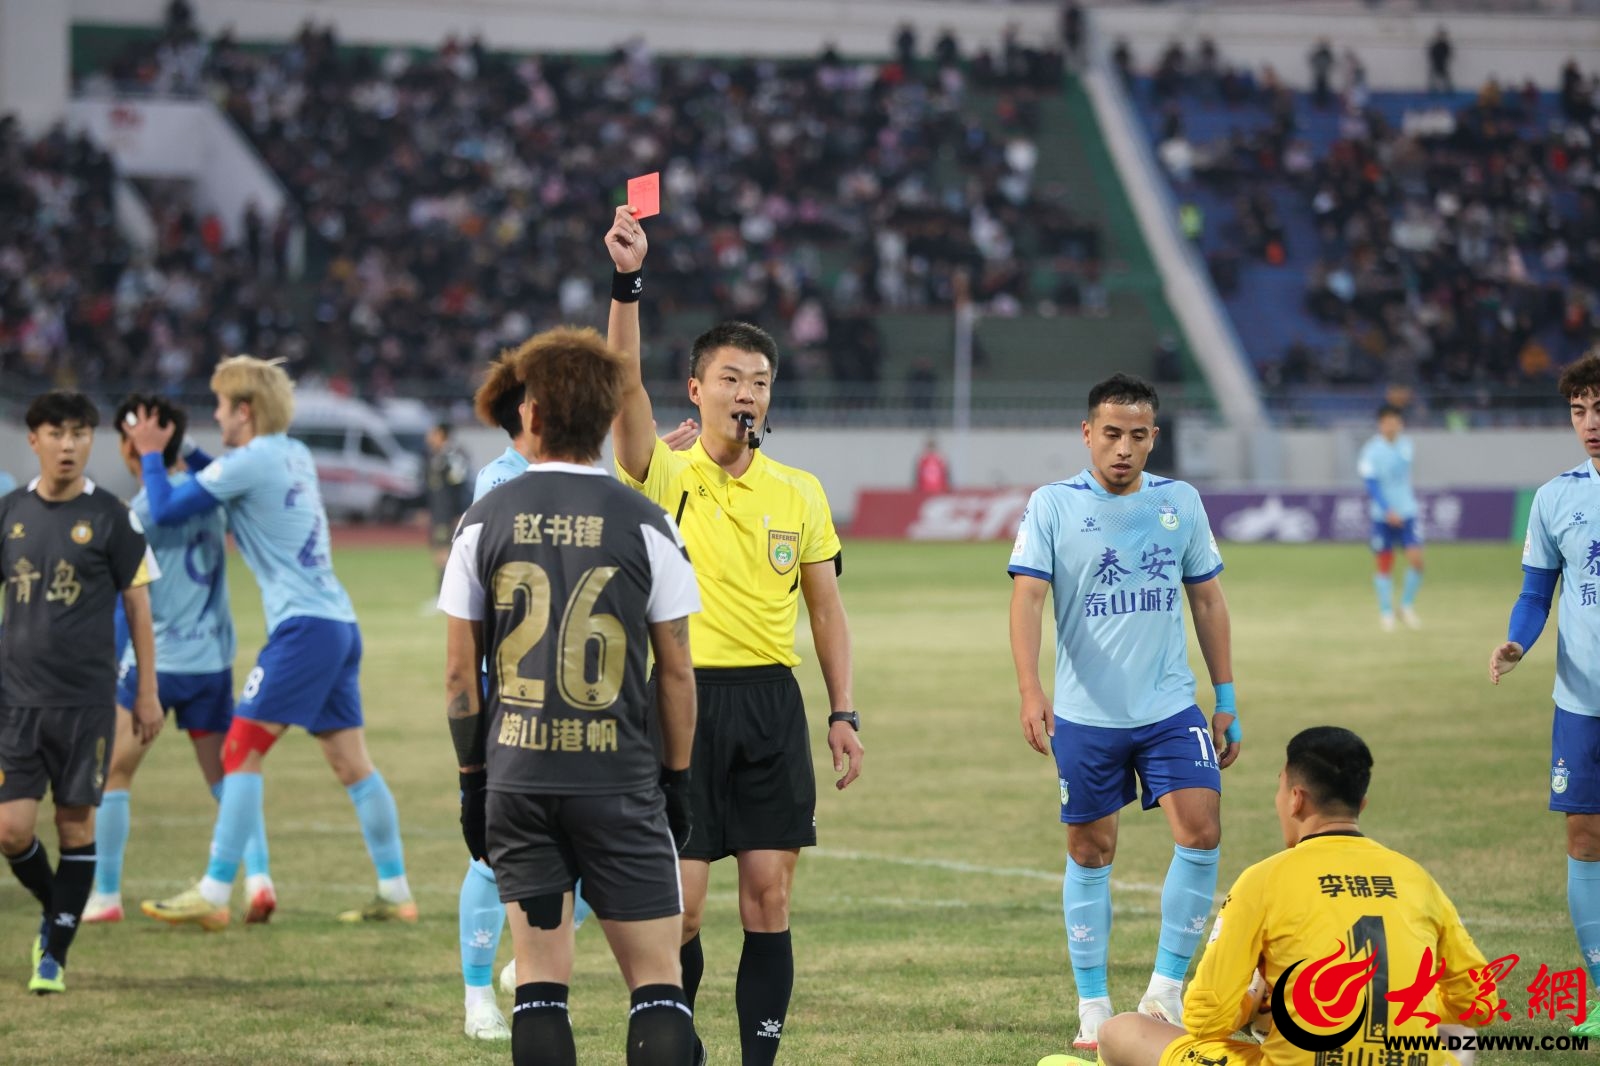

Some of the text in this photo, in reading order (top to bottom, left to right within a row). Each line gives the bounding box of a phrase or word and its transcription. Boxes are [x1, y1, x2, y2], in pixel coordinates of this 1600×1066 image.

[513, 513, 604, 547] 赵书锋
[771, 533, 797, 542] REFEREE
[9, 558, 81, 606] 青岛
[1093, 544, 1176, 586] 泰安
[491, 561, 628, 711] 26
[497, 712, 620, 753] 崂山港帆
[1318, 874, 1398, 899] 李锦昊
[1347, 915, 1389, 1043] 1
